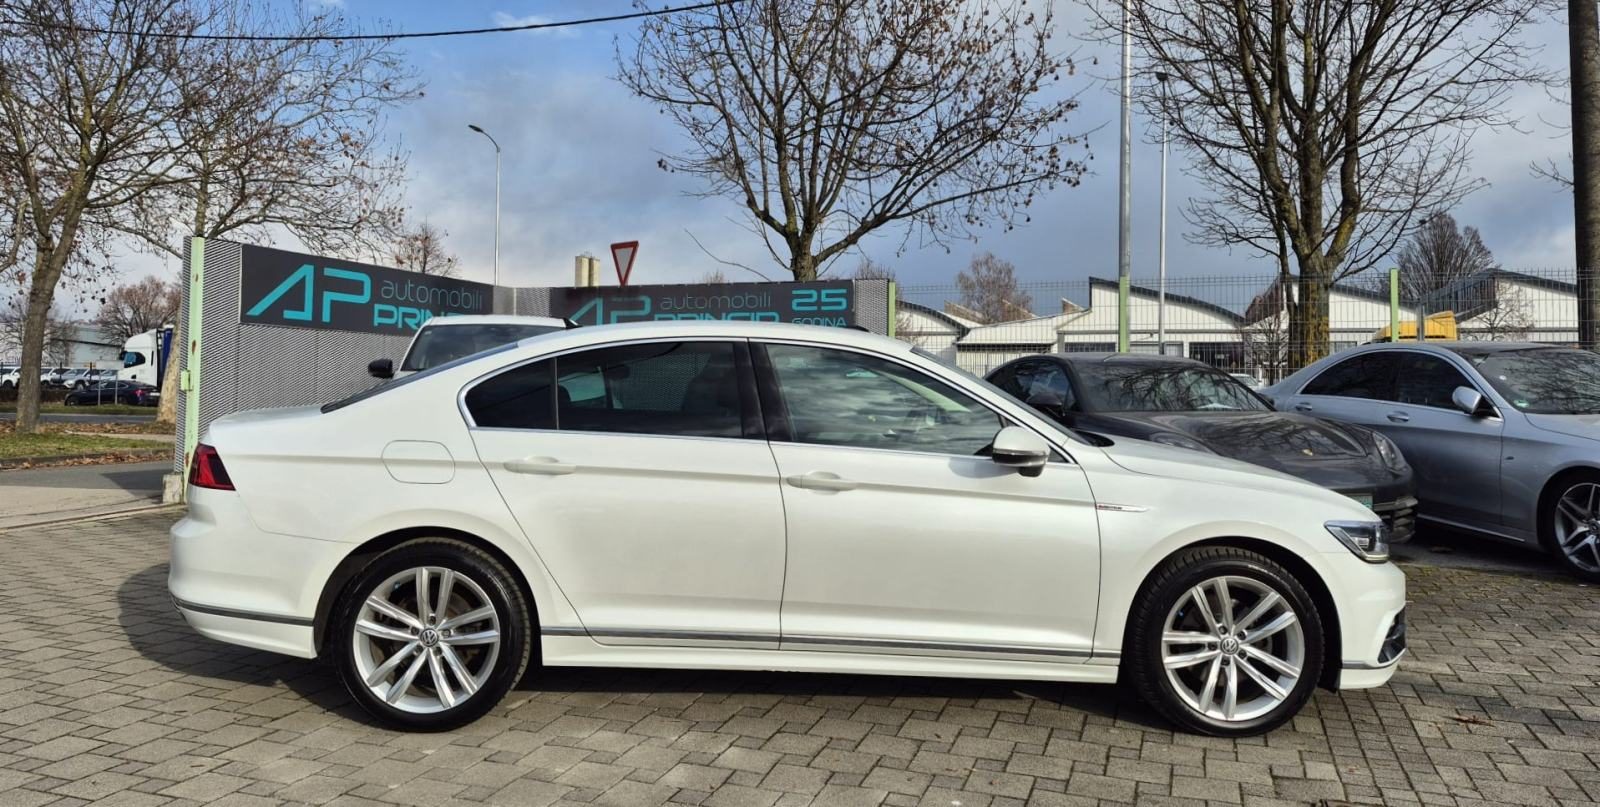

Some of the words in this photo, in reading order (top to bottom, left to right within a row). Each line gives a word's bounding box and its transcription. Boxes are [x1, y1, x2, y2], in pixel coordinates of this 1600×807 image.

[246, 264, 371, 322] AP
[381, 279, 482, 309] automobili
[660, 291, 771, 310] automobili
[791, 288, 848, 311] 25
[569, 295, 652, 327] AP
